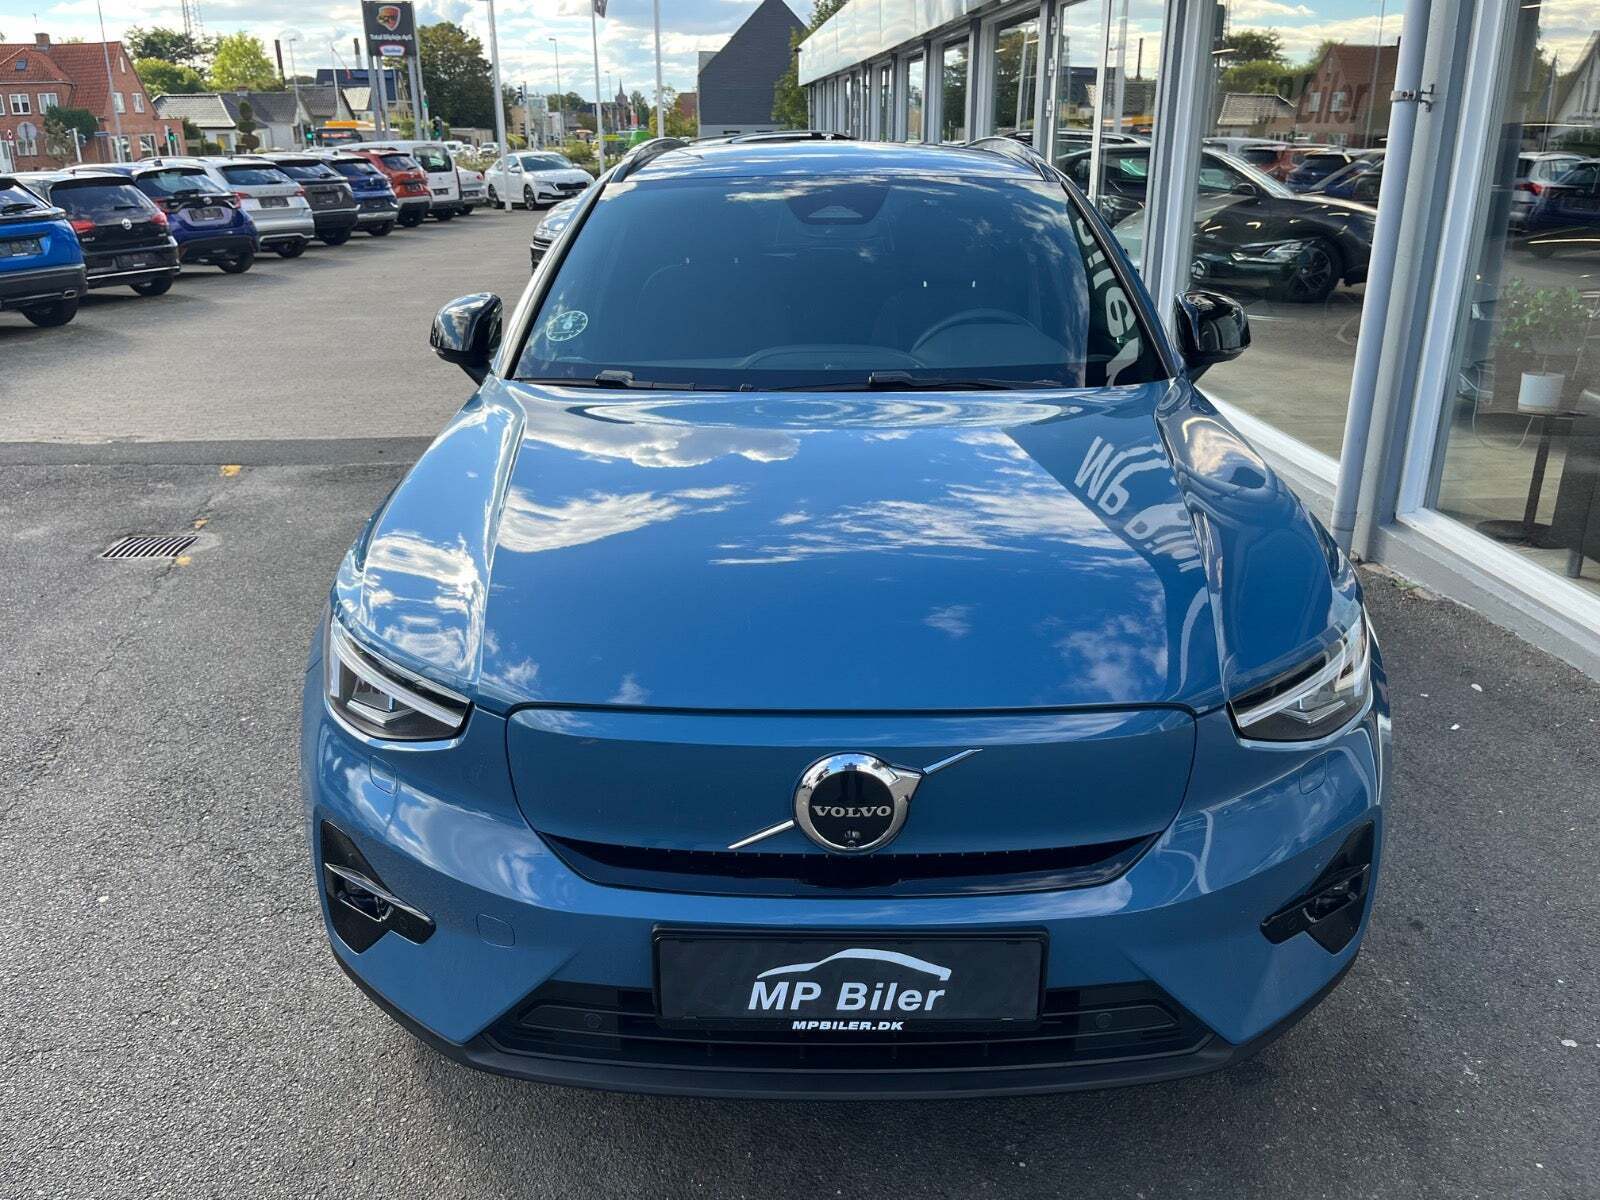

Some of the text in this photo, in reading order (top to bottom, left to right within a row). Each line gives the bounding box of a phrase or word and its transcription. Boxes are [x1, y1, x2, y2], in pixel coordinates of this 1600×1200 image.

[812, 805, 892, 818] VOLVO
[747, 981, 946, 1011] MP Biler
[792, 1021, 905, 1031] MPBILER.DK
